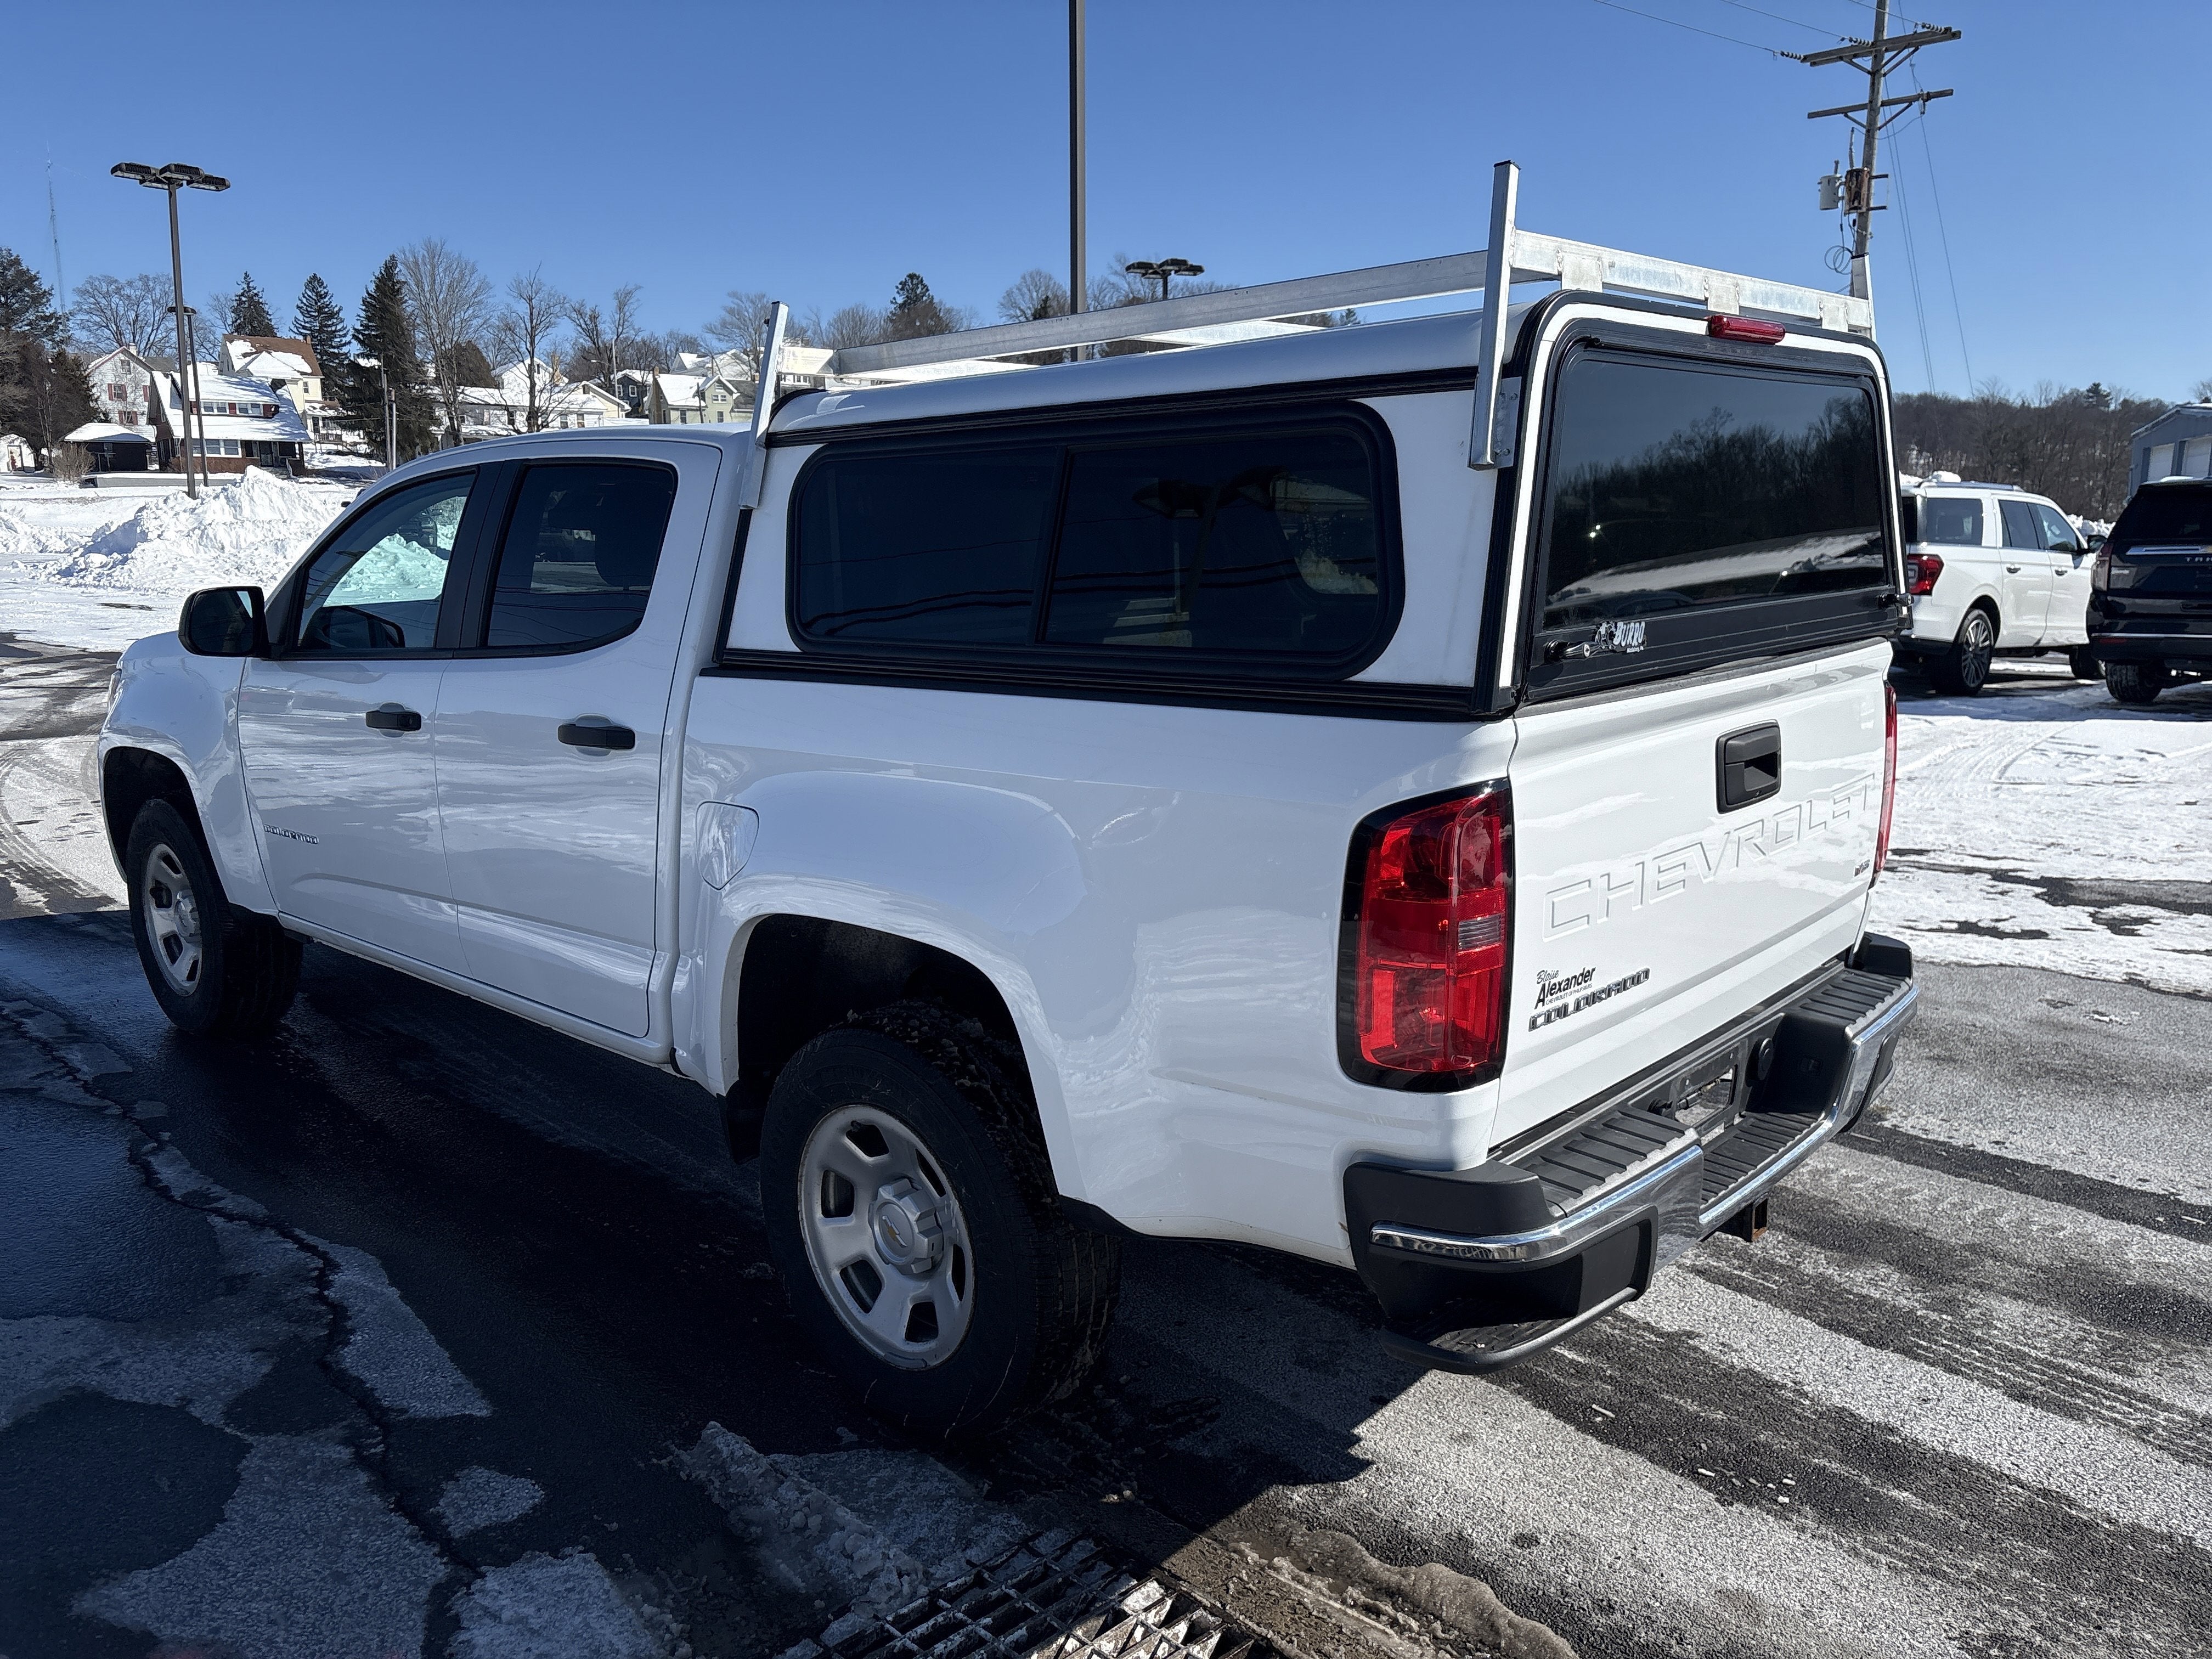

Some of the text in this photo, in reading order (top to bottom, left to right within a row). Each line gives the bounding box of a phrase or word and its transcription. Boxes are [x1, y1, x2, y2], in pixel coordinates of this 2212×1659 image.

[1613, 622, 1645, 647] BURRO
[1543, 772, 1875, 942] CHEVROLET
[1534, 967, 1596, 1010] Alexander
[1537, 969, 1559, 985] Blaise
[1528, 968, 1650, 1032] COLORADO
[1545, 992, 1568, 1005] CHEVROLET
